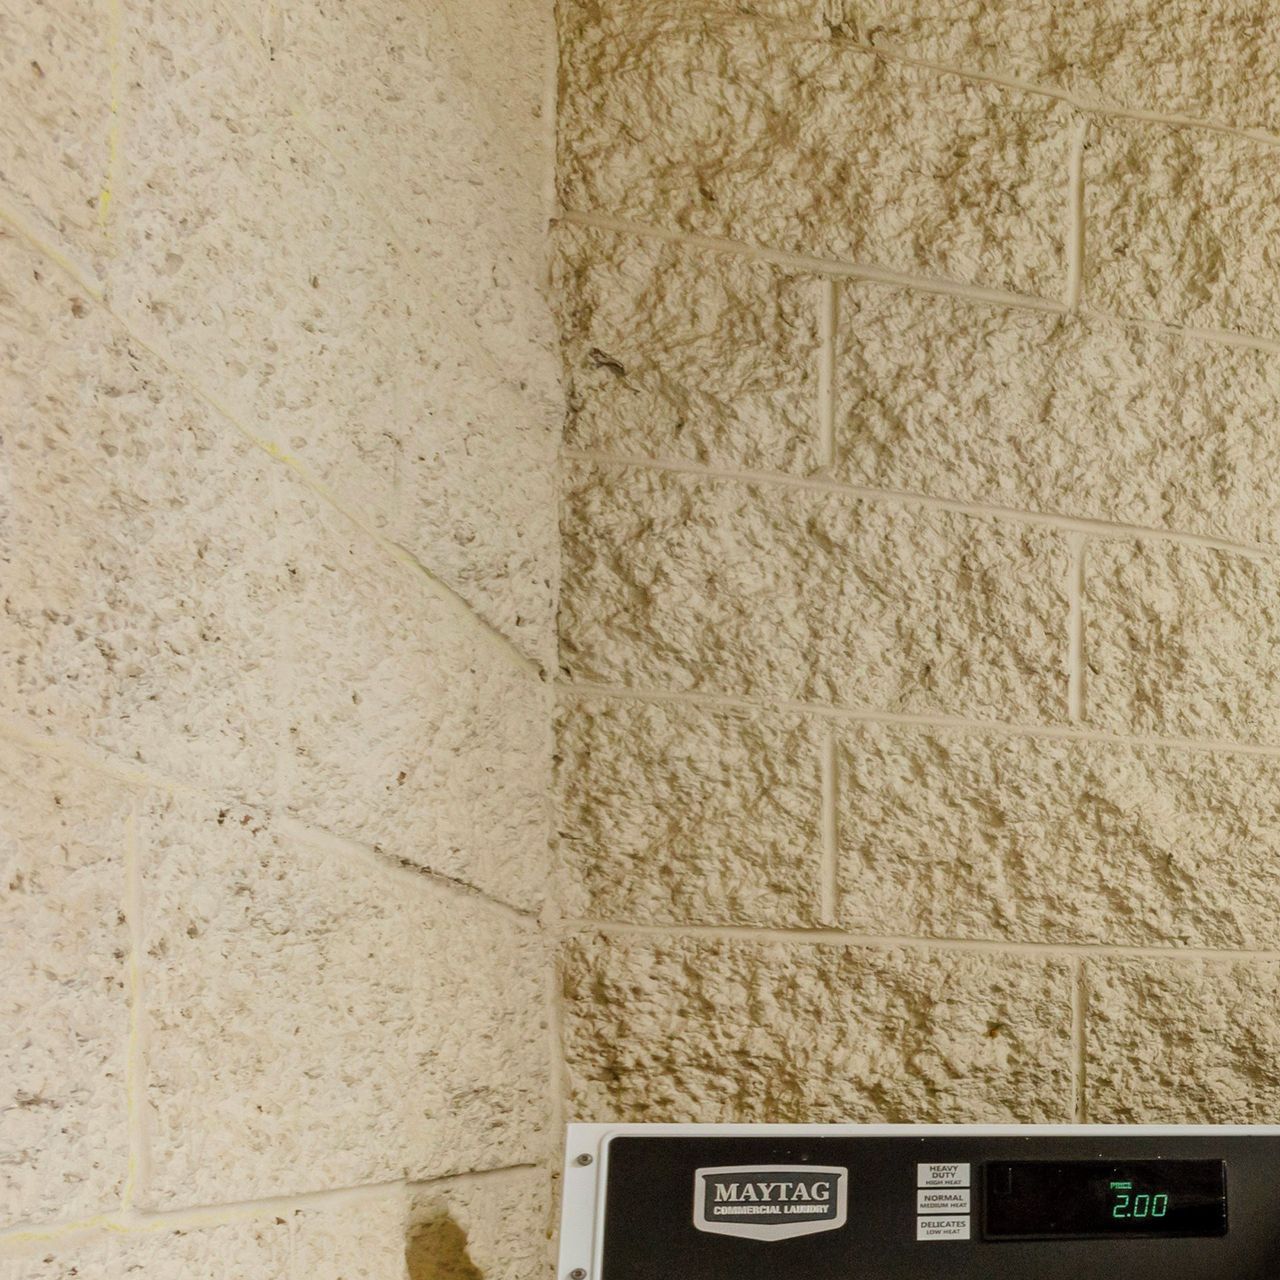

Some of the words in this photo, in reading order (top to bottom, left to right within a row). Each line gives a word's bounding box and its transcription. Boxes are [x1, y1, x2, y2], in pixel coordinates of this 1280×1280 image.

[714, 1181, 830, 1202] MAYTAG
[713, 1204, 782, 1215] COMMERCIAL
[783, 1204, 829, 1214] LAUNDRY
[1113, 1194, 1168, 1217] 2.00
